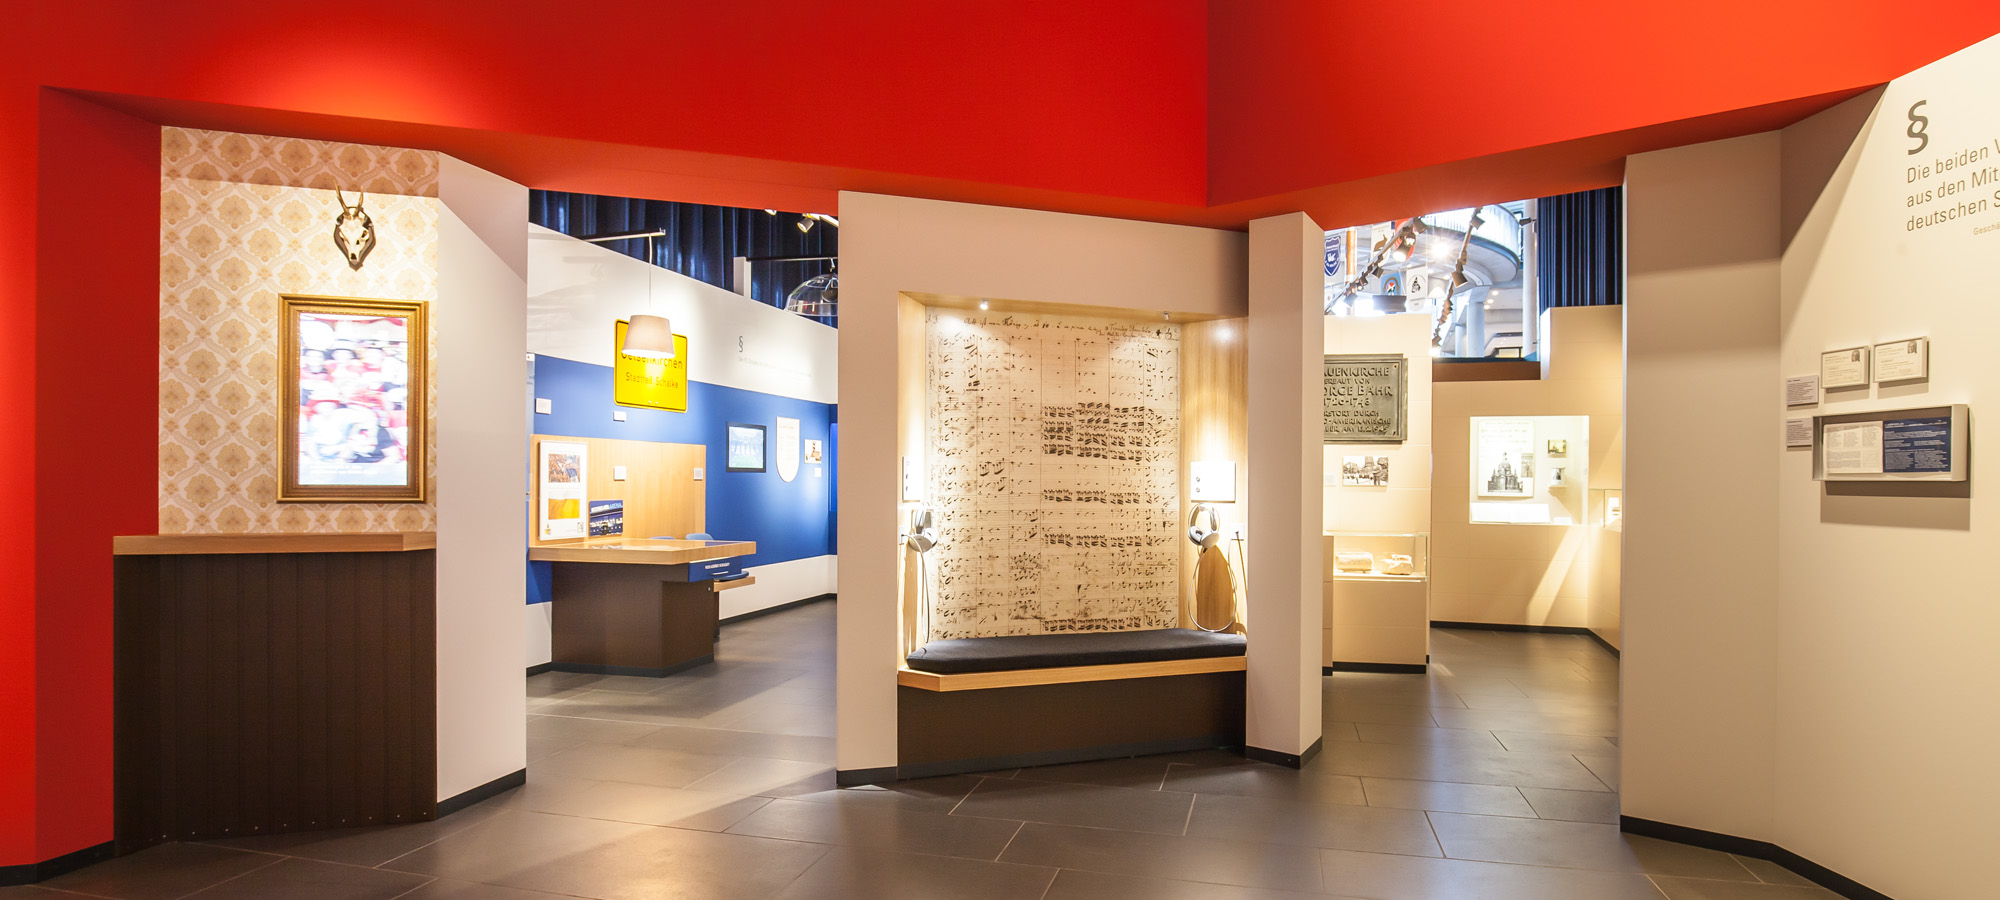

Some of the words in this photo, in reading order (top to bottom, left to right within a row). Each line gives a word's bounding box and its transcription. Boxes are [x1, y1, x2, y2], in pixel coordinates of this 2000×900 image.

[1907, 164, 1930, 184] Die
[1936, 146, 1988, 175] beiden
[1906, 189, 1932, 208] aus
[1938, 179, 1966, 199] den
[1971, 166, 1998, 189] Mit
[1906, 198, 1987, 232] deutschen
[625, 371, 653, 385] Stadtteil
[655, 376, 679, 389] Schalke
